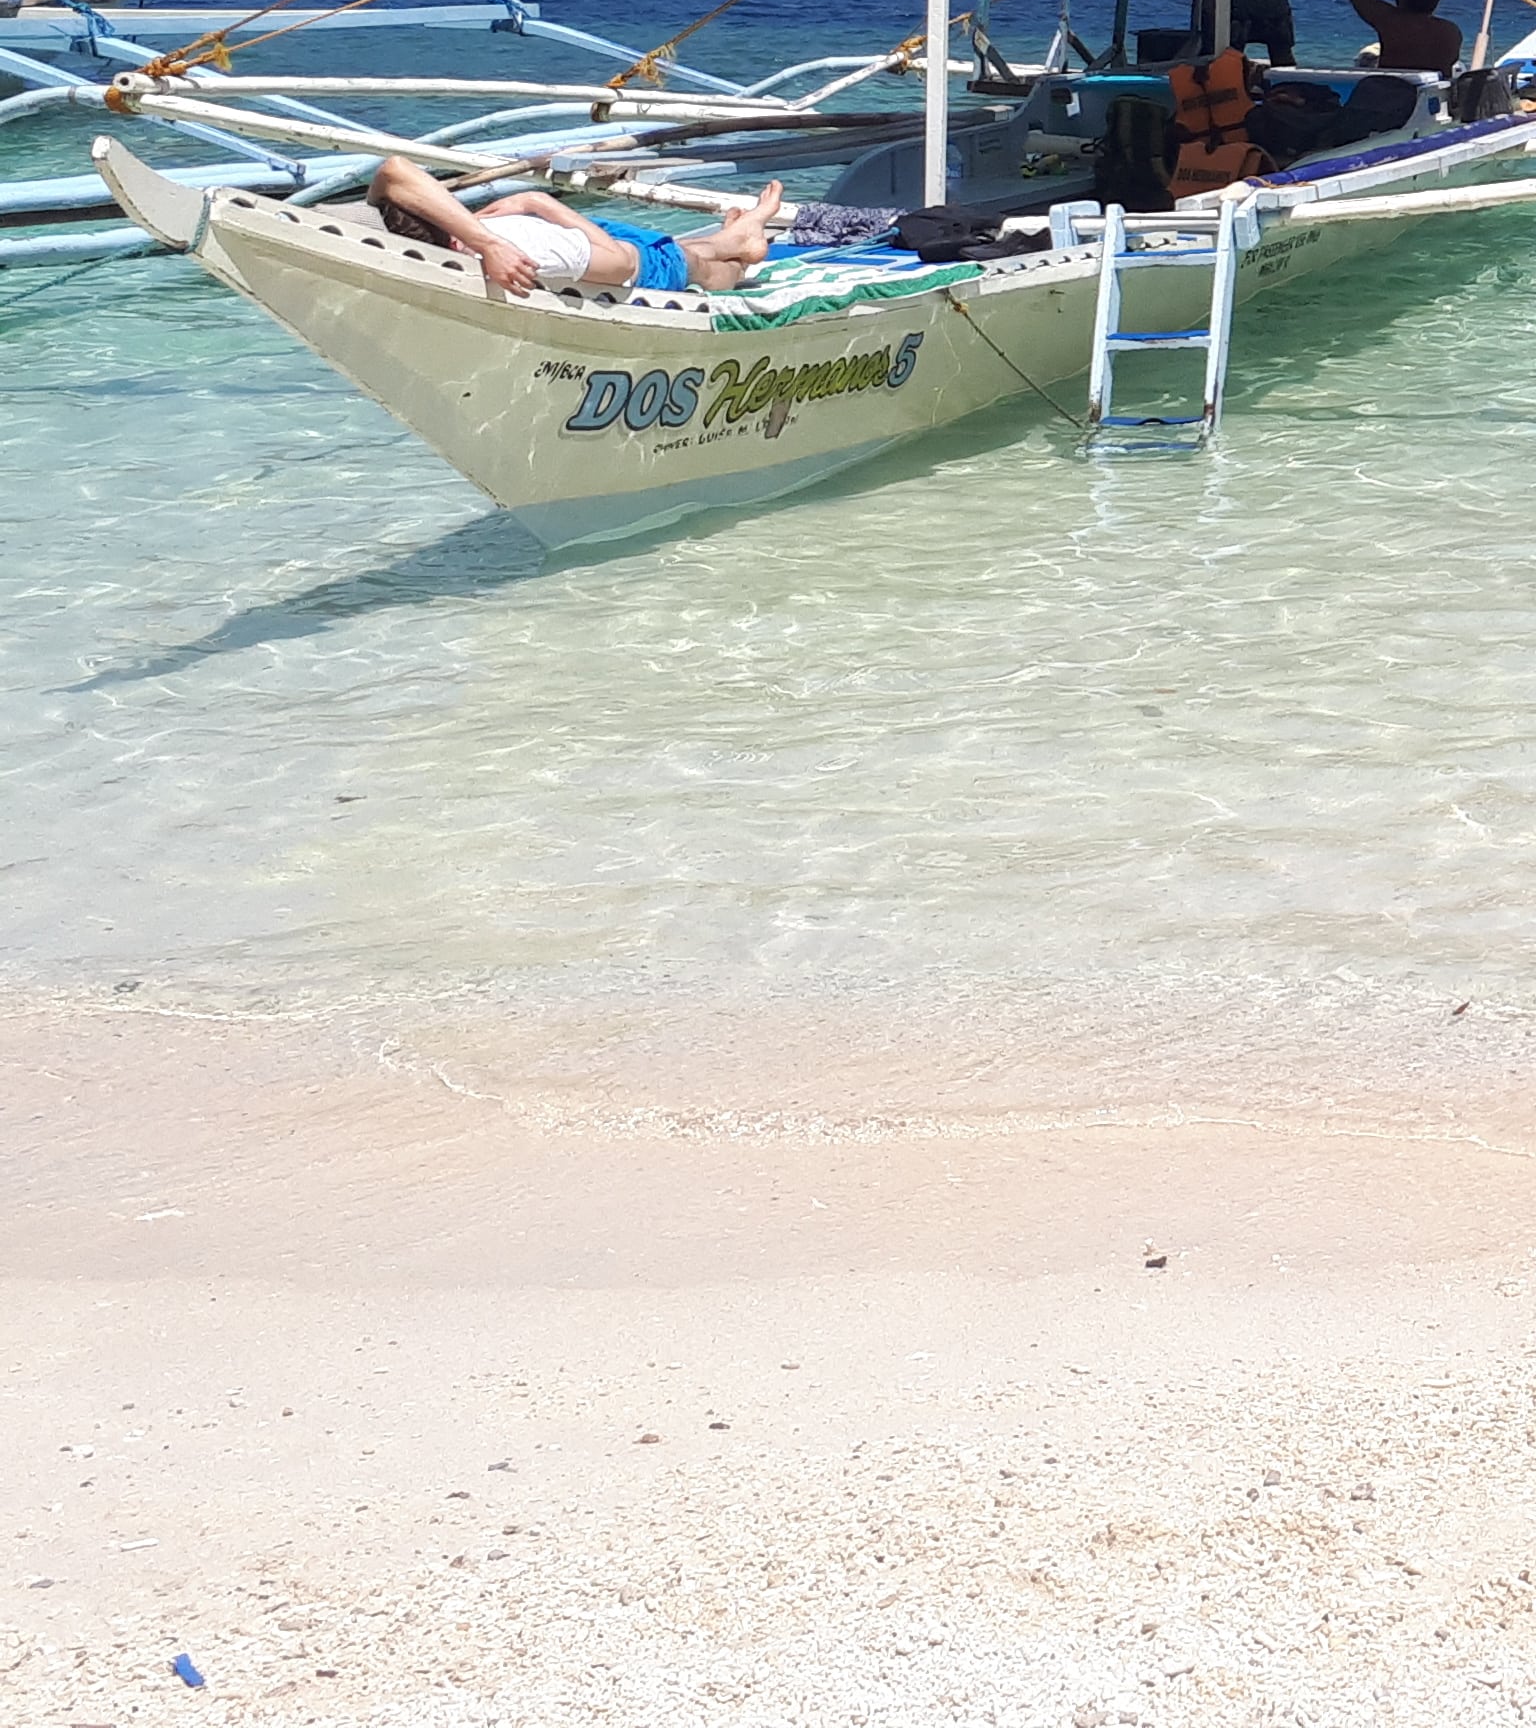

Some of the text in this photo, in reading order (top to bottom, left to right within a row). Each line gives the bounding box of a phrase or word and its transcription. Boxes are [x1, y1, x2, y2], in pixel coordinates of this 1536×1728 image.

[566, 368, 705, 431] DOS
[703, 344, 891, 429] Hermanos
[888, 332, 925, 387] 5
